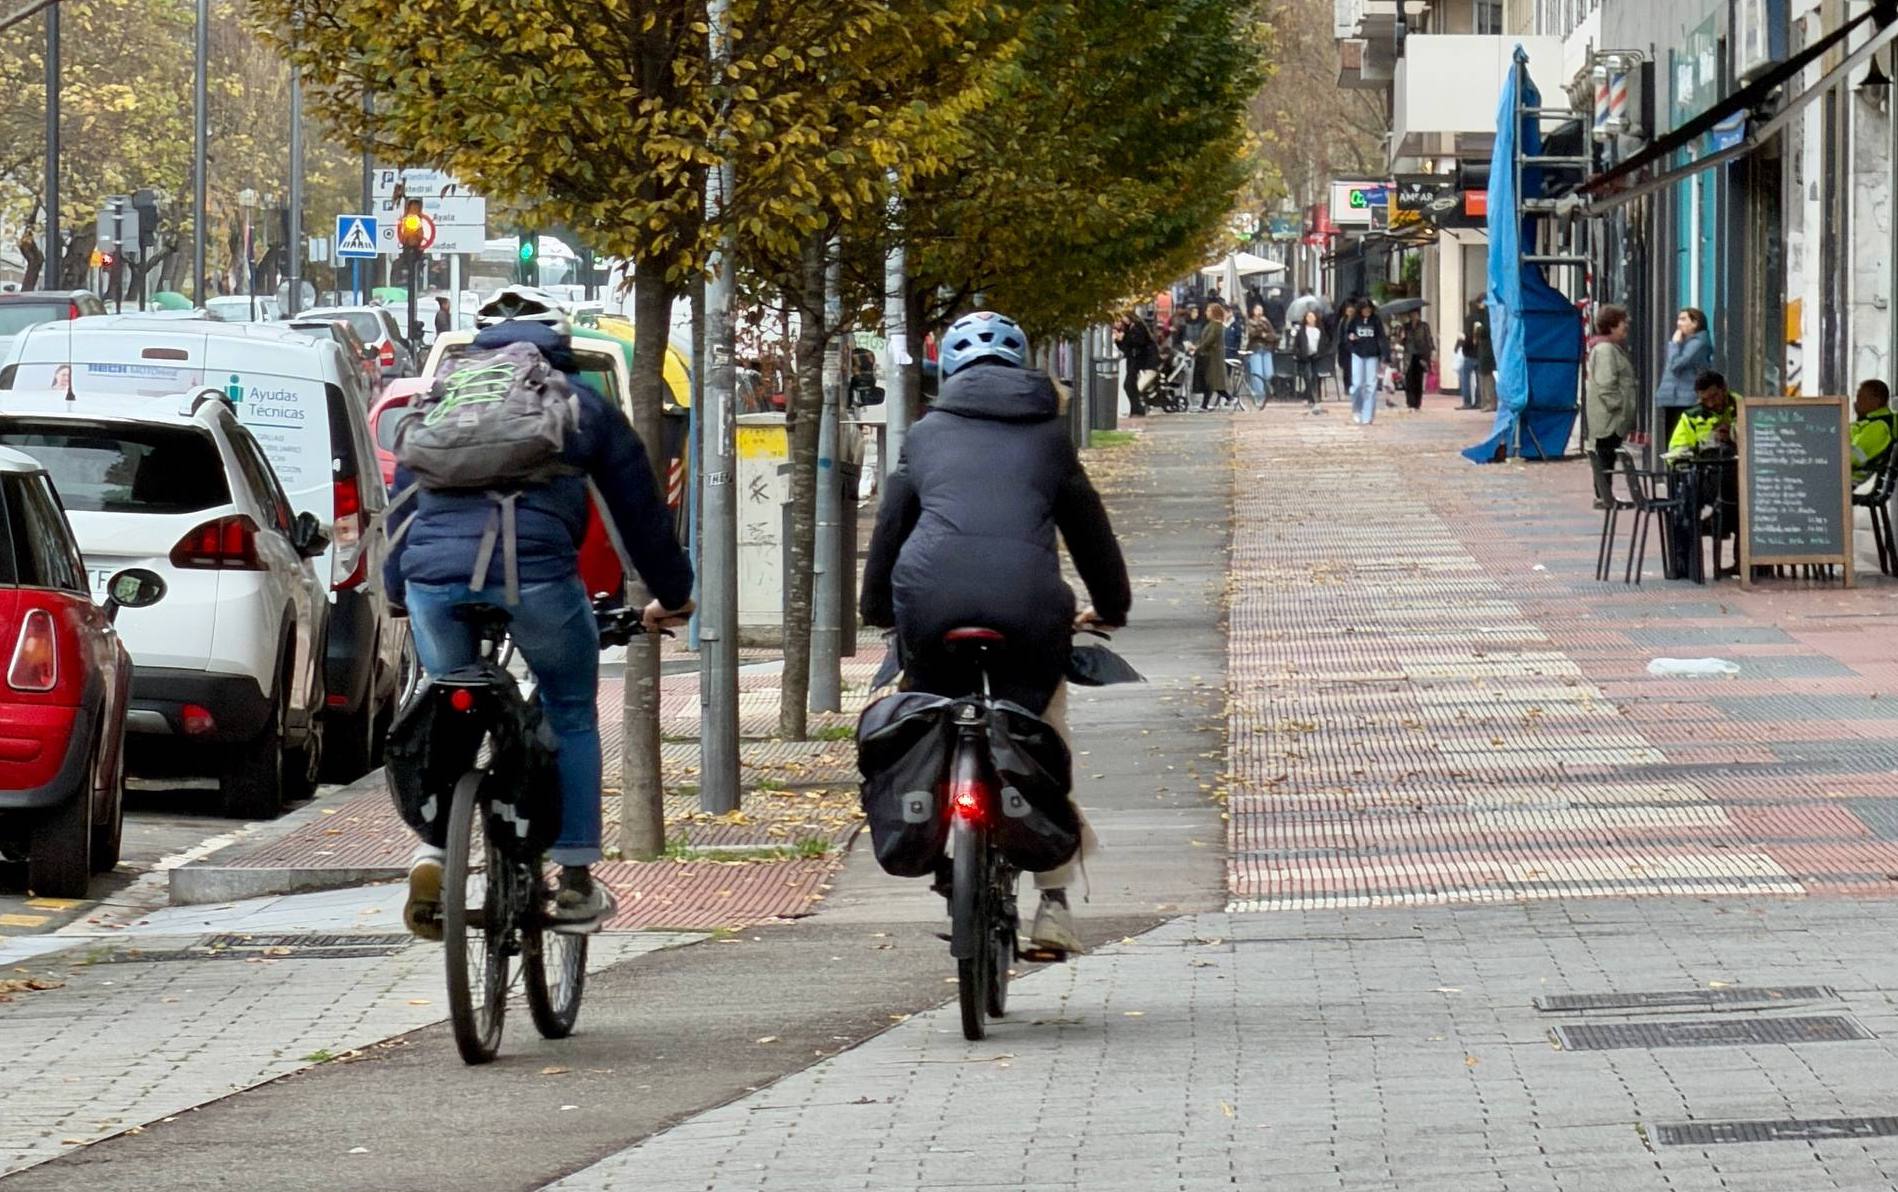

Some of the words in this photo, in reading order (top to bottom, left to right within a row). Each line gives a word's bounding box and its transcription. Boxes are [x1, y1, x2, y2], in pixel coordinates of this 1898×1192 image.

[433, 213, 455, 222] Ayala
[249, 387, 298, 402] Ayudas
[249, 403, 305, 420] Técnicas
